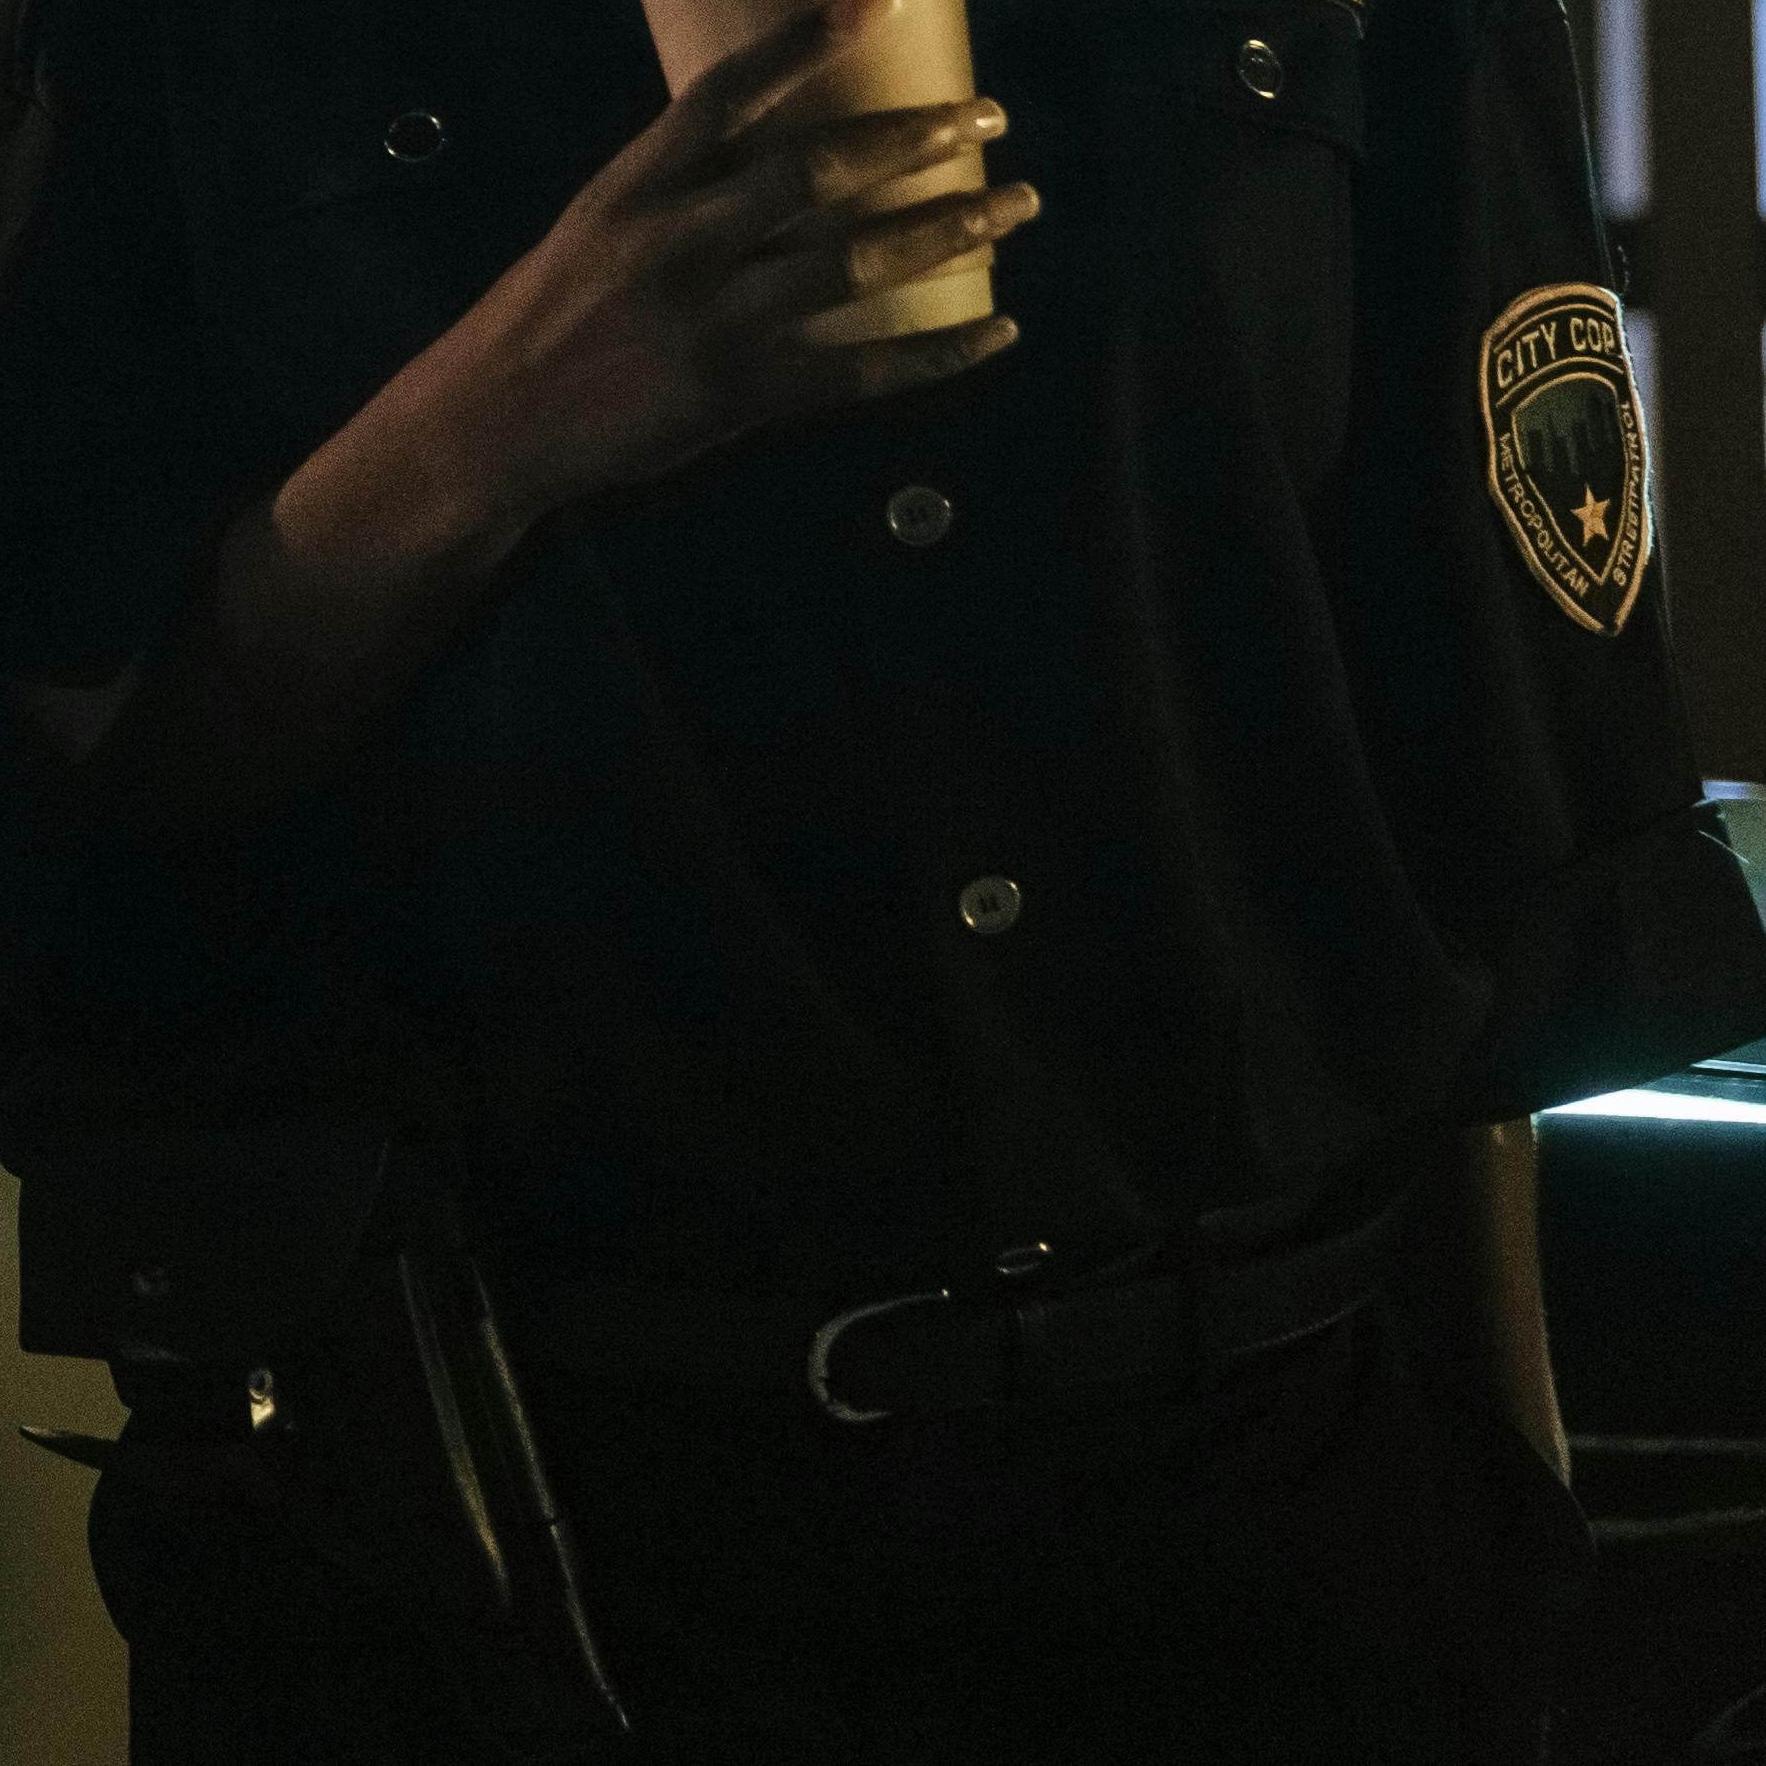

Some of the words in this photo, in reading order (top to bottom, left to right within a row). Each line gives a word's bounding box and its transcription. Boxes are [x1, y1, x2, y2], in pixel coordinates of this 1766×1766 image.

[1496, 320, 1557, 389] CITY
[1569, 316, 1617, 355] COP
[1499, 432, 1591, 598] METROPOLITAN
